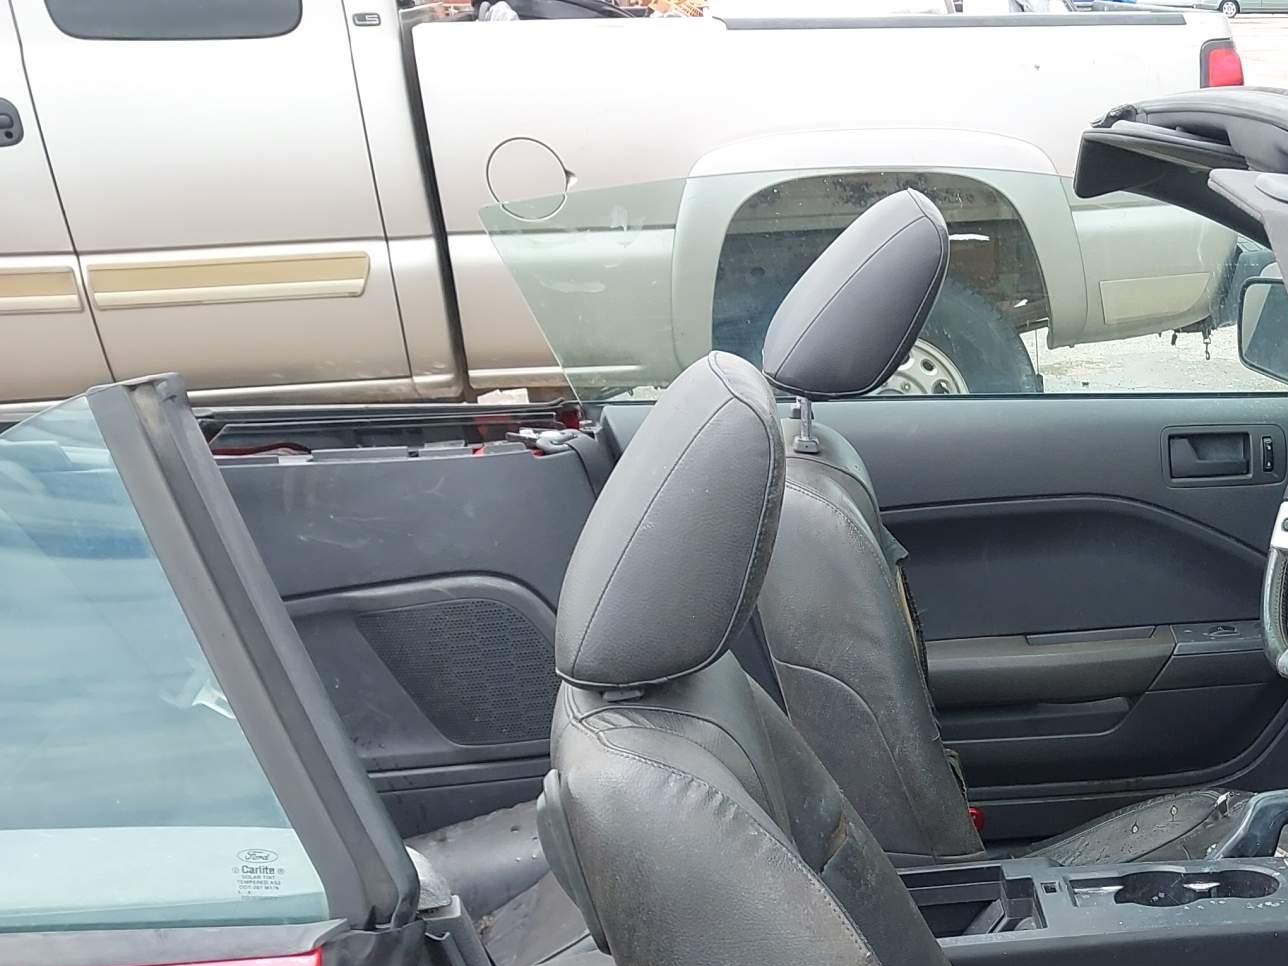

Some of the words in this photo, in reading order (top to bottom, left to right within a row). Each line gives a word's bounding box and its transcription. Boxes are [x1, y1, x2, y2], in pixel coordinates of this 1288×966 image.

[354, 14, 379, 25] LS
[244, 851, 270, 861] Ford
[241, 864, 275, 874] Carlite
